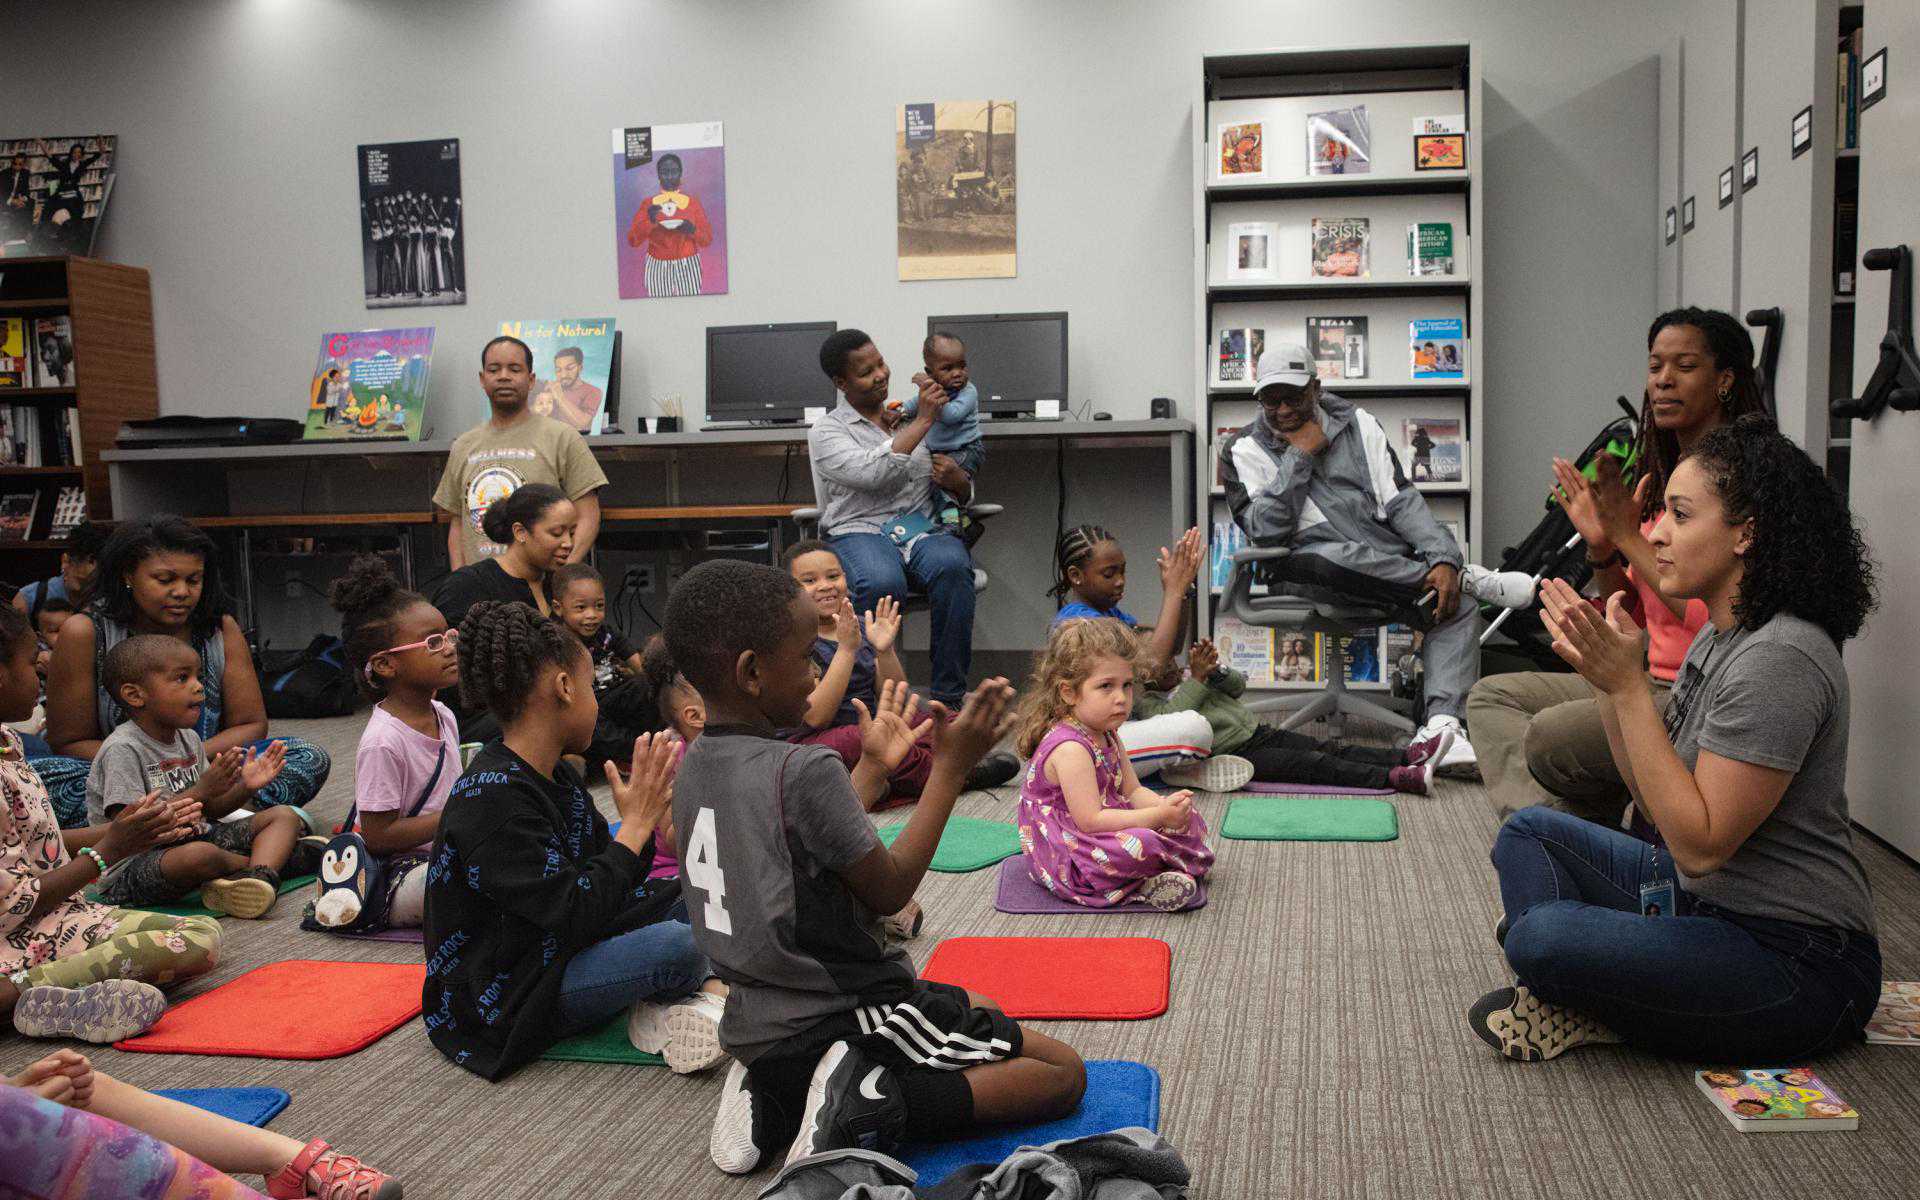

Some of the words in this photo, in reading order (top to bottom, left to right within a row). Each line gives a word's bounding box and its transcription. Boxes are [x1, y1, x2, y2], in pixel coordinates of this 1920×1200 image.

[1314, 224, 1364, 239] CRISIS
[556, 323, 606, 337] Natural
[477, 771, 510, 785] ROCK
[685, 806, 733, 937] 4
